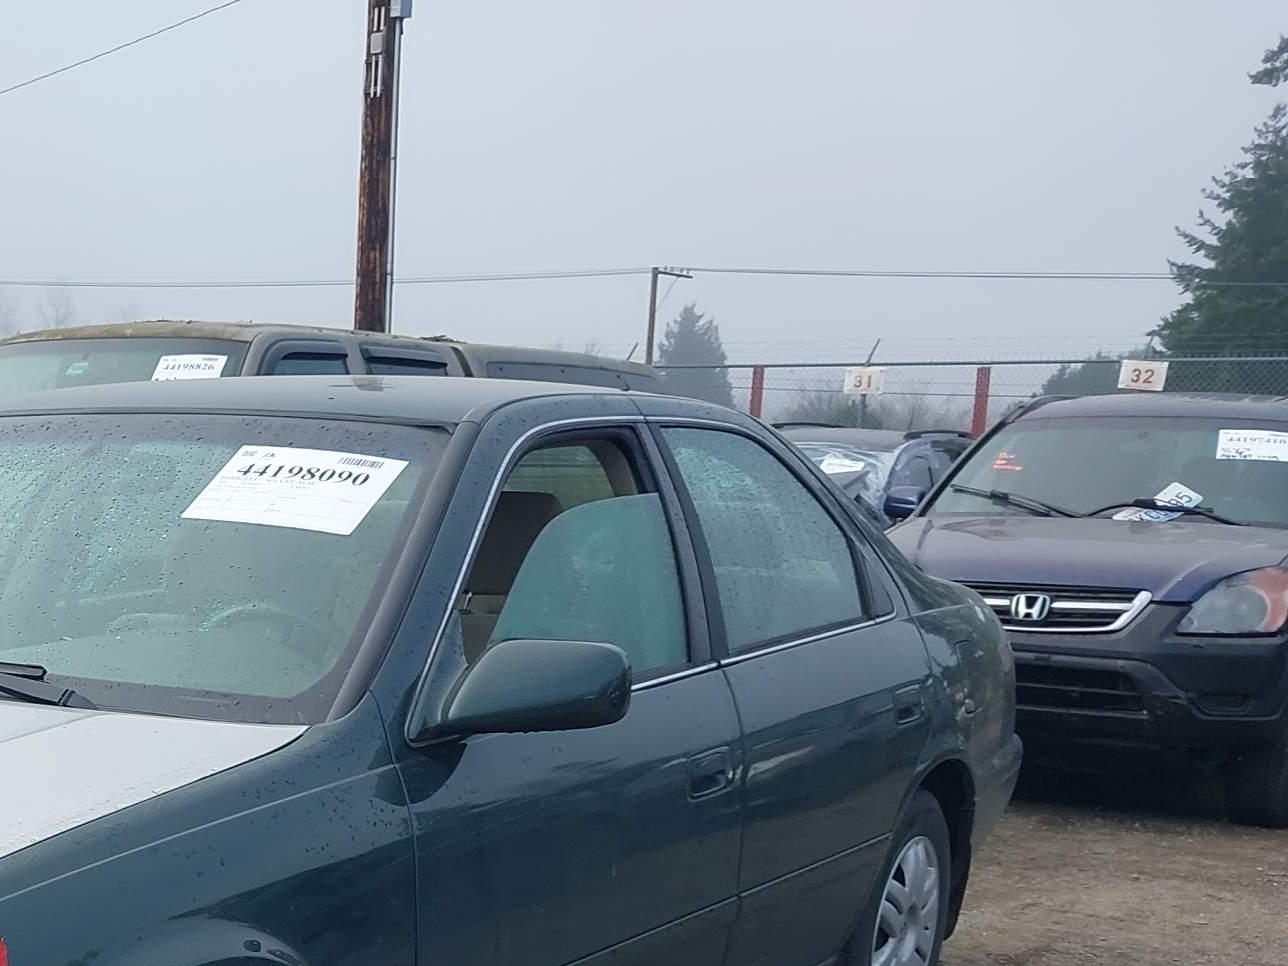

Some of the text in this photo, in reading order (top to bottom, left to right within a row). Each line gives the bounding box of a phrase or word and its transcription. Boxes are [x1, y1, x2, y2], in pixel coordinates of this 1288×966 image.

[853, 374, 873, 389] 31
[1130, 367, 1155, 385] 32
[237, 463, 370, 486] 44198090
